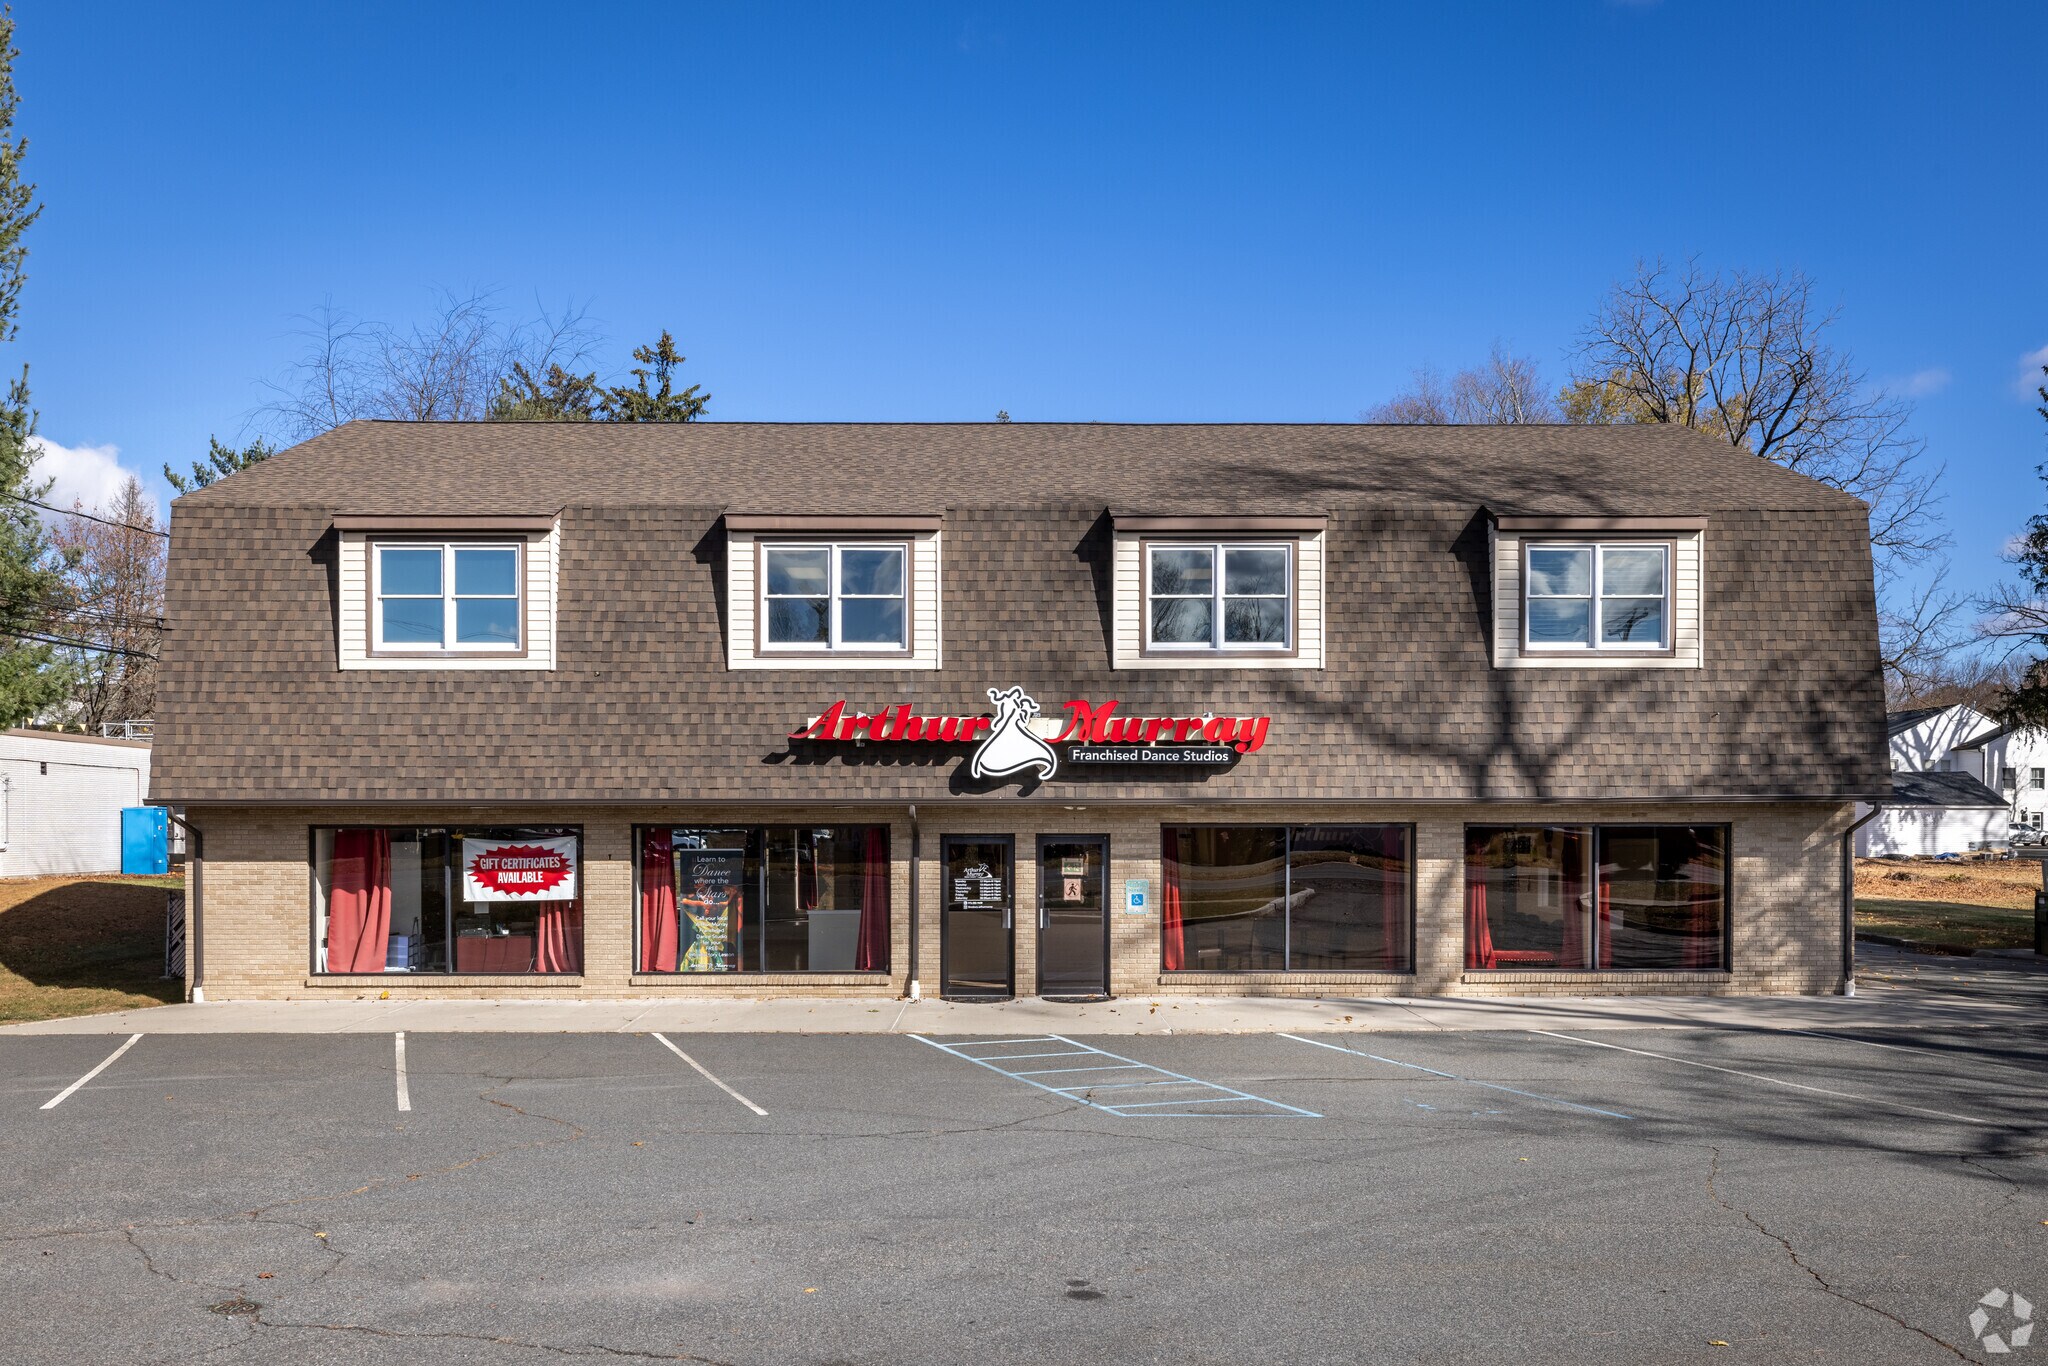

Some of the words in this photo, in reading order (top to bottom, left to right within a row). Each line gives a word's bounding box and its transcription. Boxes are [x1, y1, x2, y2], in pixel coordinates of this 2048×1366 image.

[788, 700, 991, 741] Arthur
[1044, 700, 1271, 753] Murray
[1072, 750, 1138, 762] Franchised
[1141, 750, 1180, 762] Dance
[1183, 750, 1229, 762] Studios
[480, 858, 500, 870] GIFT
[501, 857, 561, 870] CERTIFICATES
[696, 855, 717, 863] Learn
[692, 863, 731, 877] Dance
[497, 871, 544, 884] AVAILABLE
[696, 885, 727, 899] Stars
